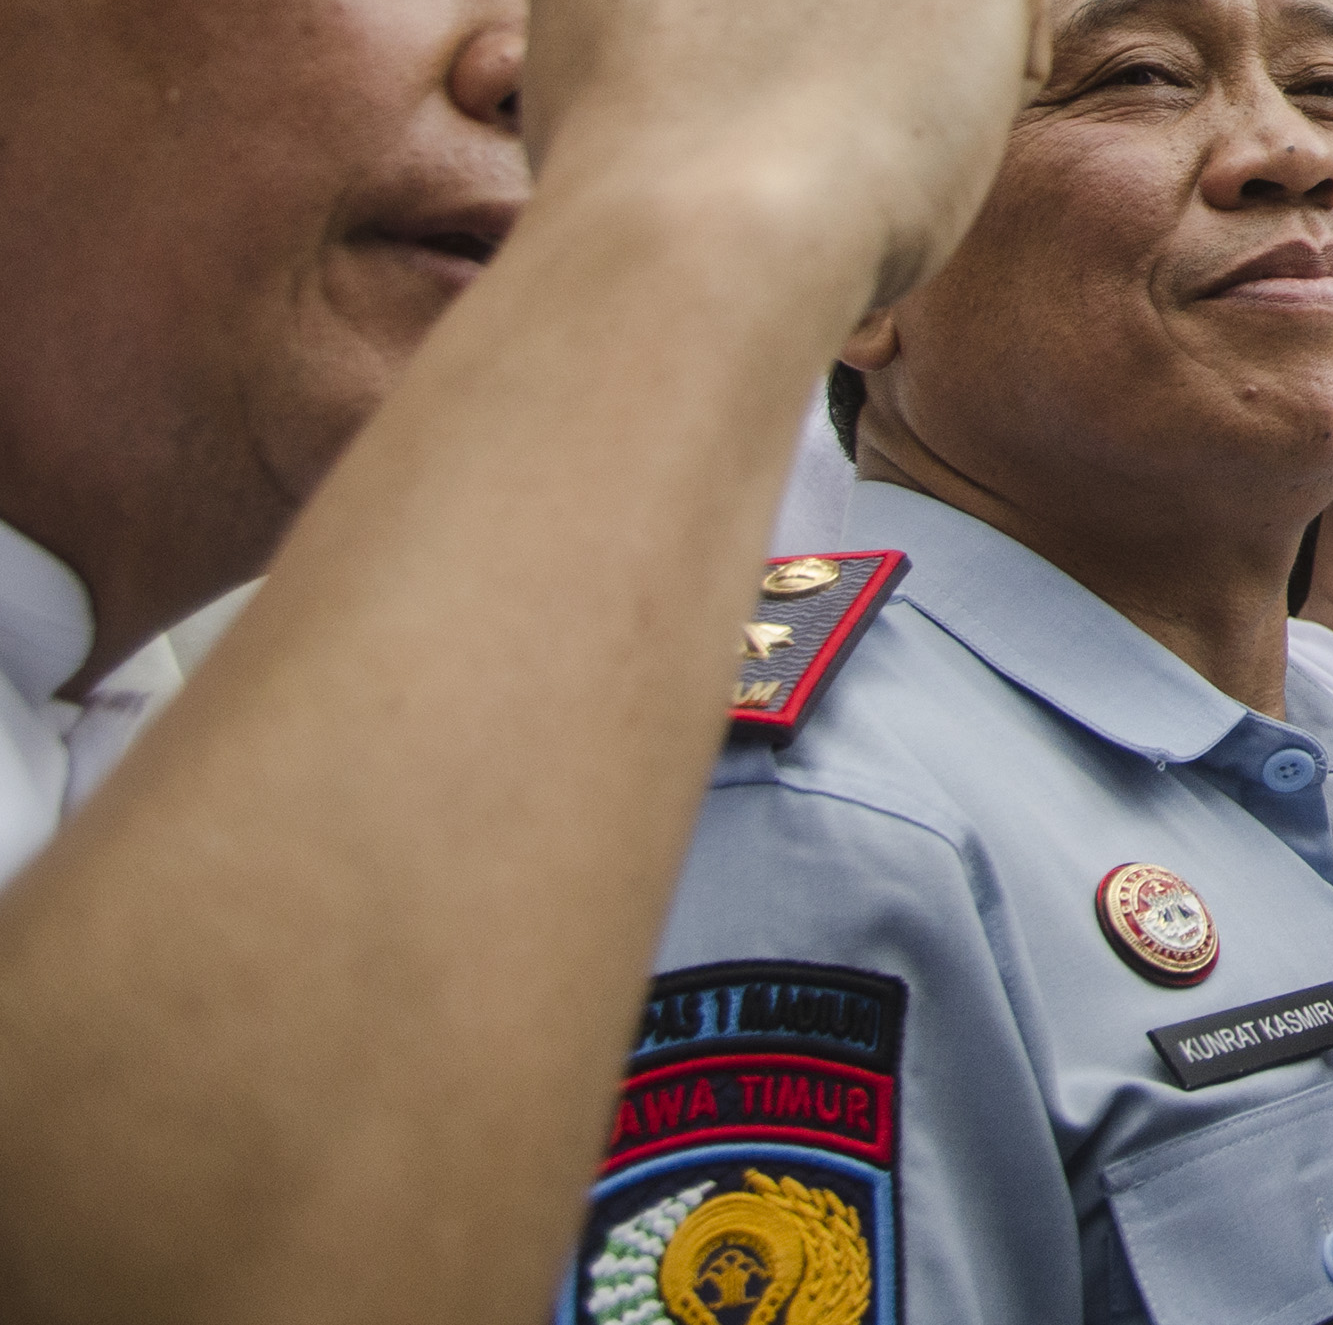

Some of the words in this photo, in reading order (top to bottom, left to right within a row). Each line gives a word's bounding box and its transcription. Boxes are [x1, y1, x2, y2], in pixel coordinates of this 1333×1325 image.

[1178, 1021, 1263, 1063] KUNRAT
[611, 1077, 718, 1144] AWA
[736, 1075, 870, 1133] TIMUR
